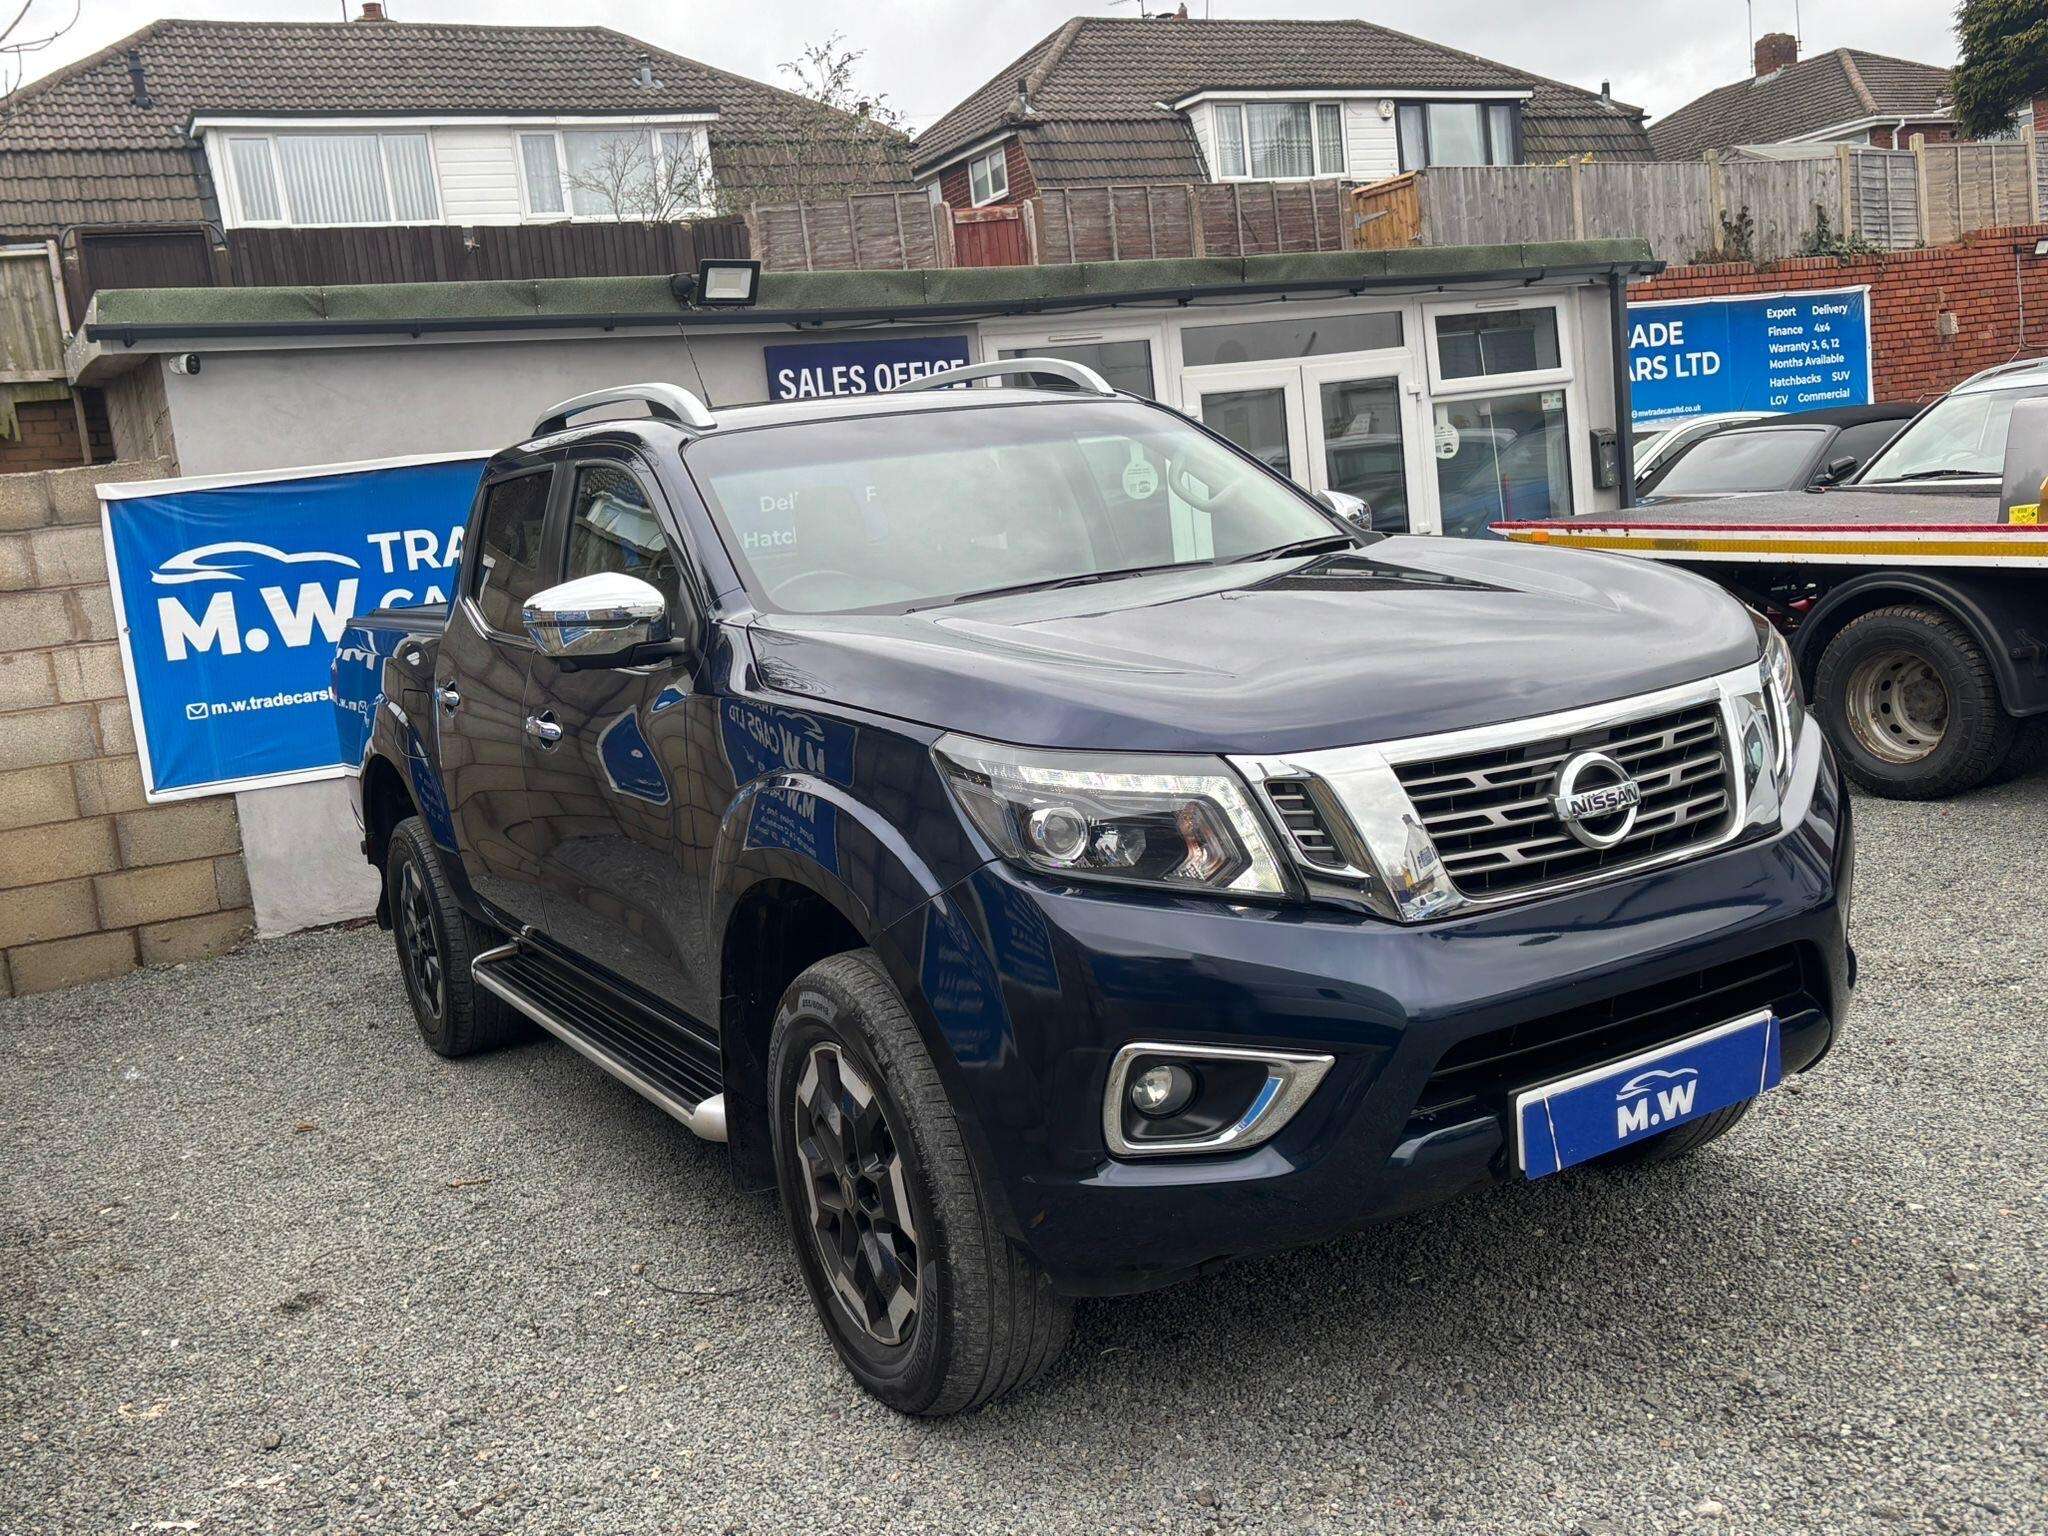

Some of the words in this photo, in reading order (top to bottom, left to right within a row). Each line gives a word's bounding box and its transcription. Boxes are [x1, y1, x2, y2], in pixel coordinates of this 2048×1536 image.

[1767, 307, 1797, 319] Export
[1812, 304, 1848, 315] Delivery
[1628, 321, 1684, 348] ADE
[1768, 325, 1804, 337] Finance
[1814, 322, 1831, 333] 4x4
[1768, 341, 1810, 354] Warranty
[1812, 340, 1820, 351] 3,
[1821, 339, 1829, 350] 6,
[1831, 338, 1840, 348] 12
[1675, 351, 1720, 378] LTD
[1769, 357, 1803, 370] Months
[1805, 354, 1845, 366] Available
[778, 365, 867, 400] SALES
[1769, 373, 1822, 388] Hatchbacks
[1831, 370, 1851, 382] SUV
[1770, 394, 1789, 406] LGV
[1797, 388, 1850, 402] Commercial
[157, 578, 358, 662] M.W
[1570, 788, 1638, 818] NISSAN
[1616, 1080, 1698, 1140] M.W
